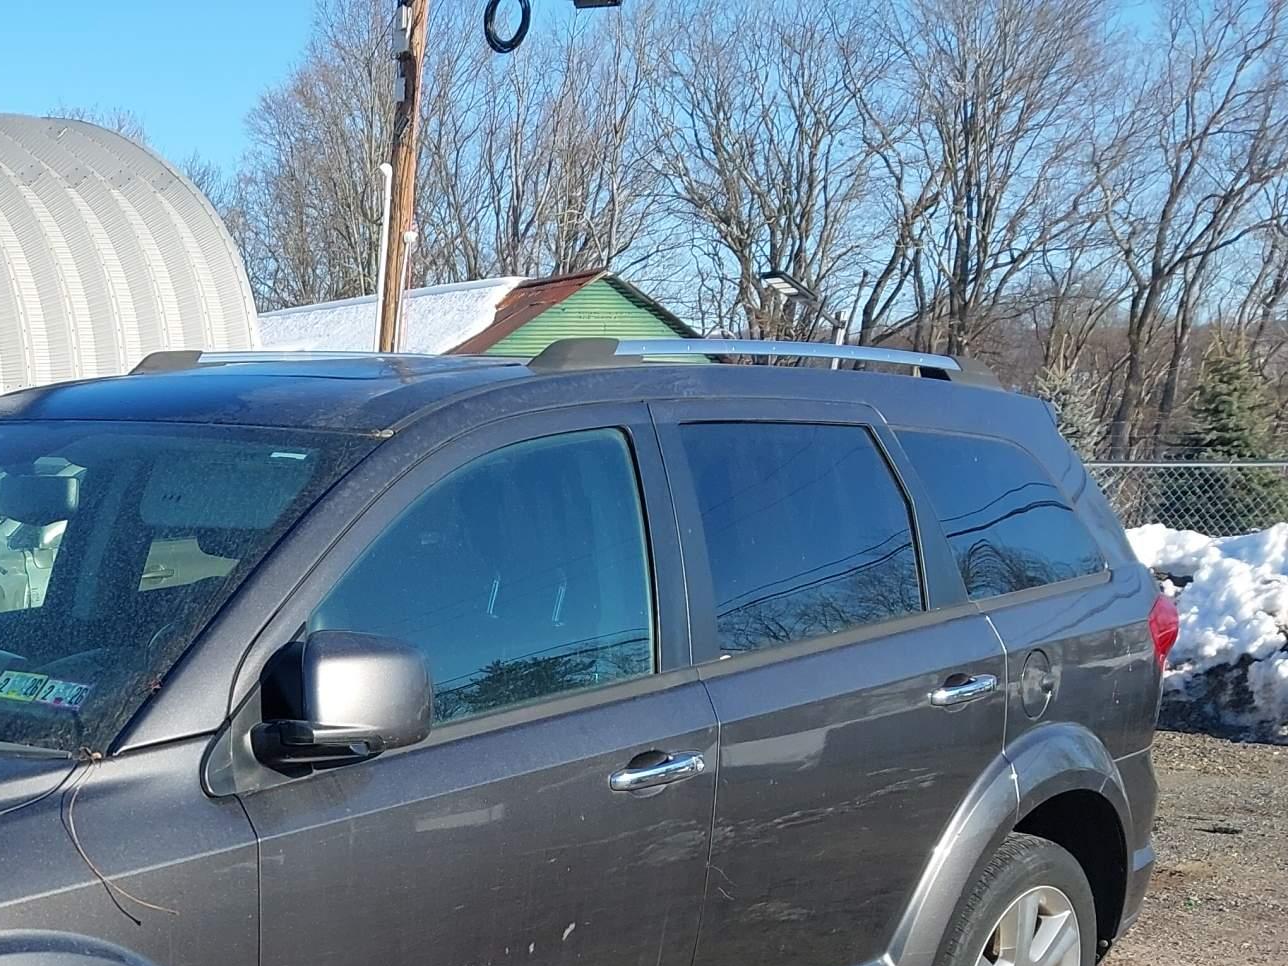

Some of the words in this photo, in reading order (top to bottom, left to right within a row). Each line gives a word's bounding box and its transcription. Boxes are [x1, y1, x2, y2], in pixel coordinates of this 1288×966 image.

[24, 678, 44, 697] 26
[41, 685, 55, 700] 2
[68, 686, 89, 705] 26
